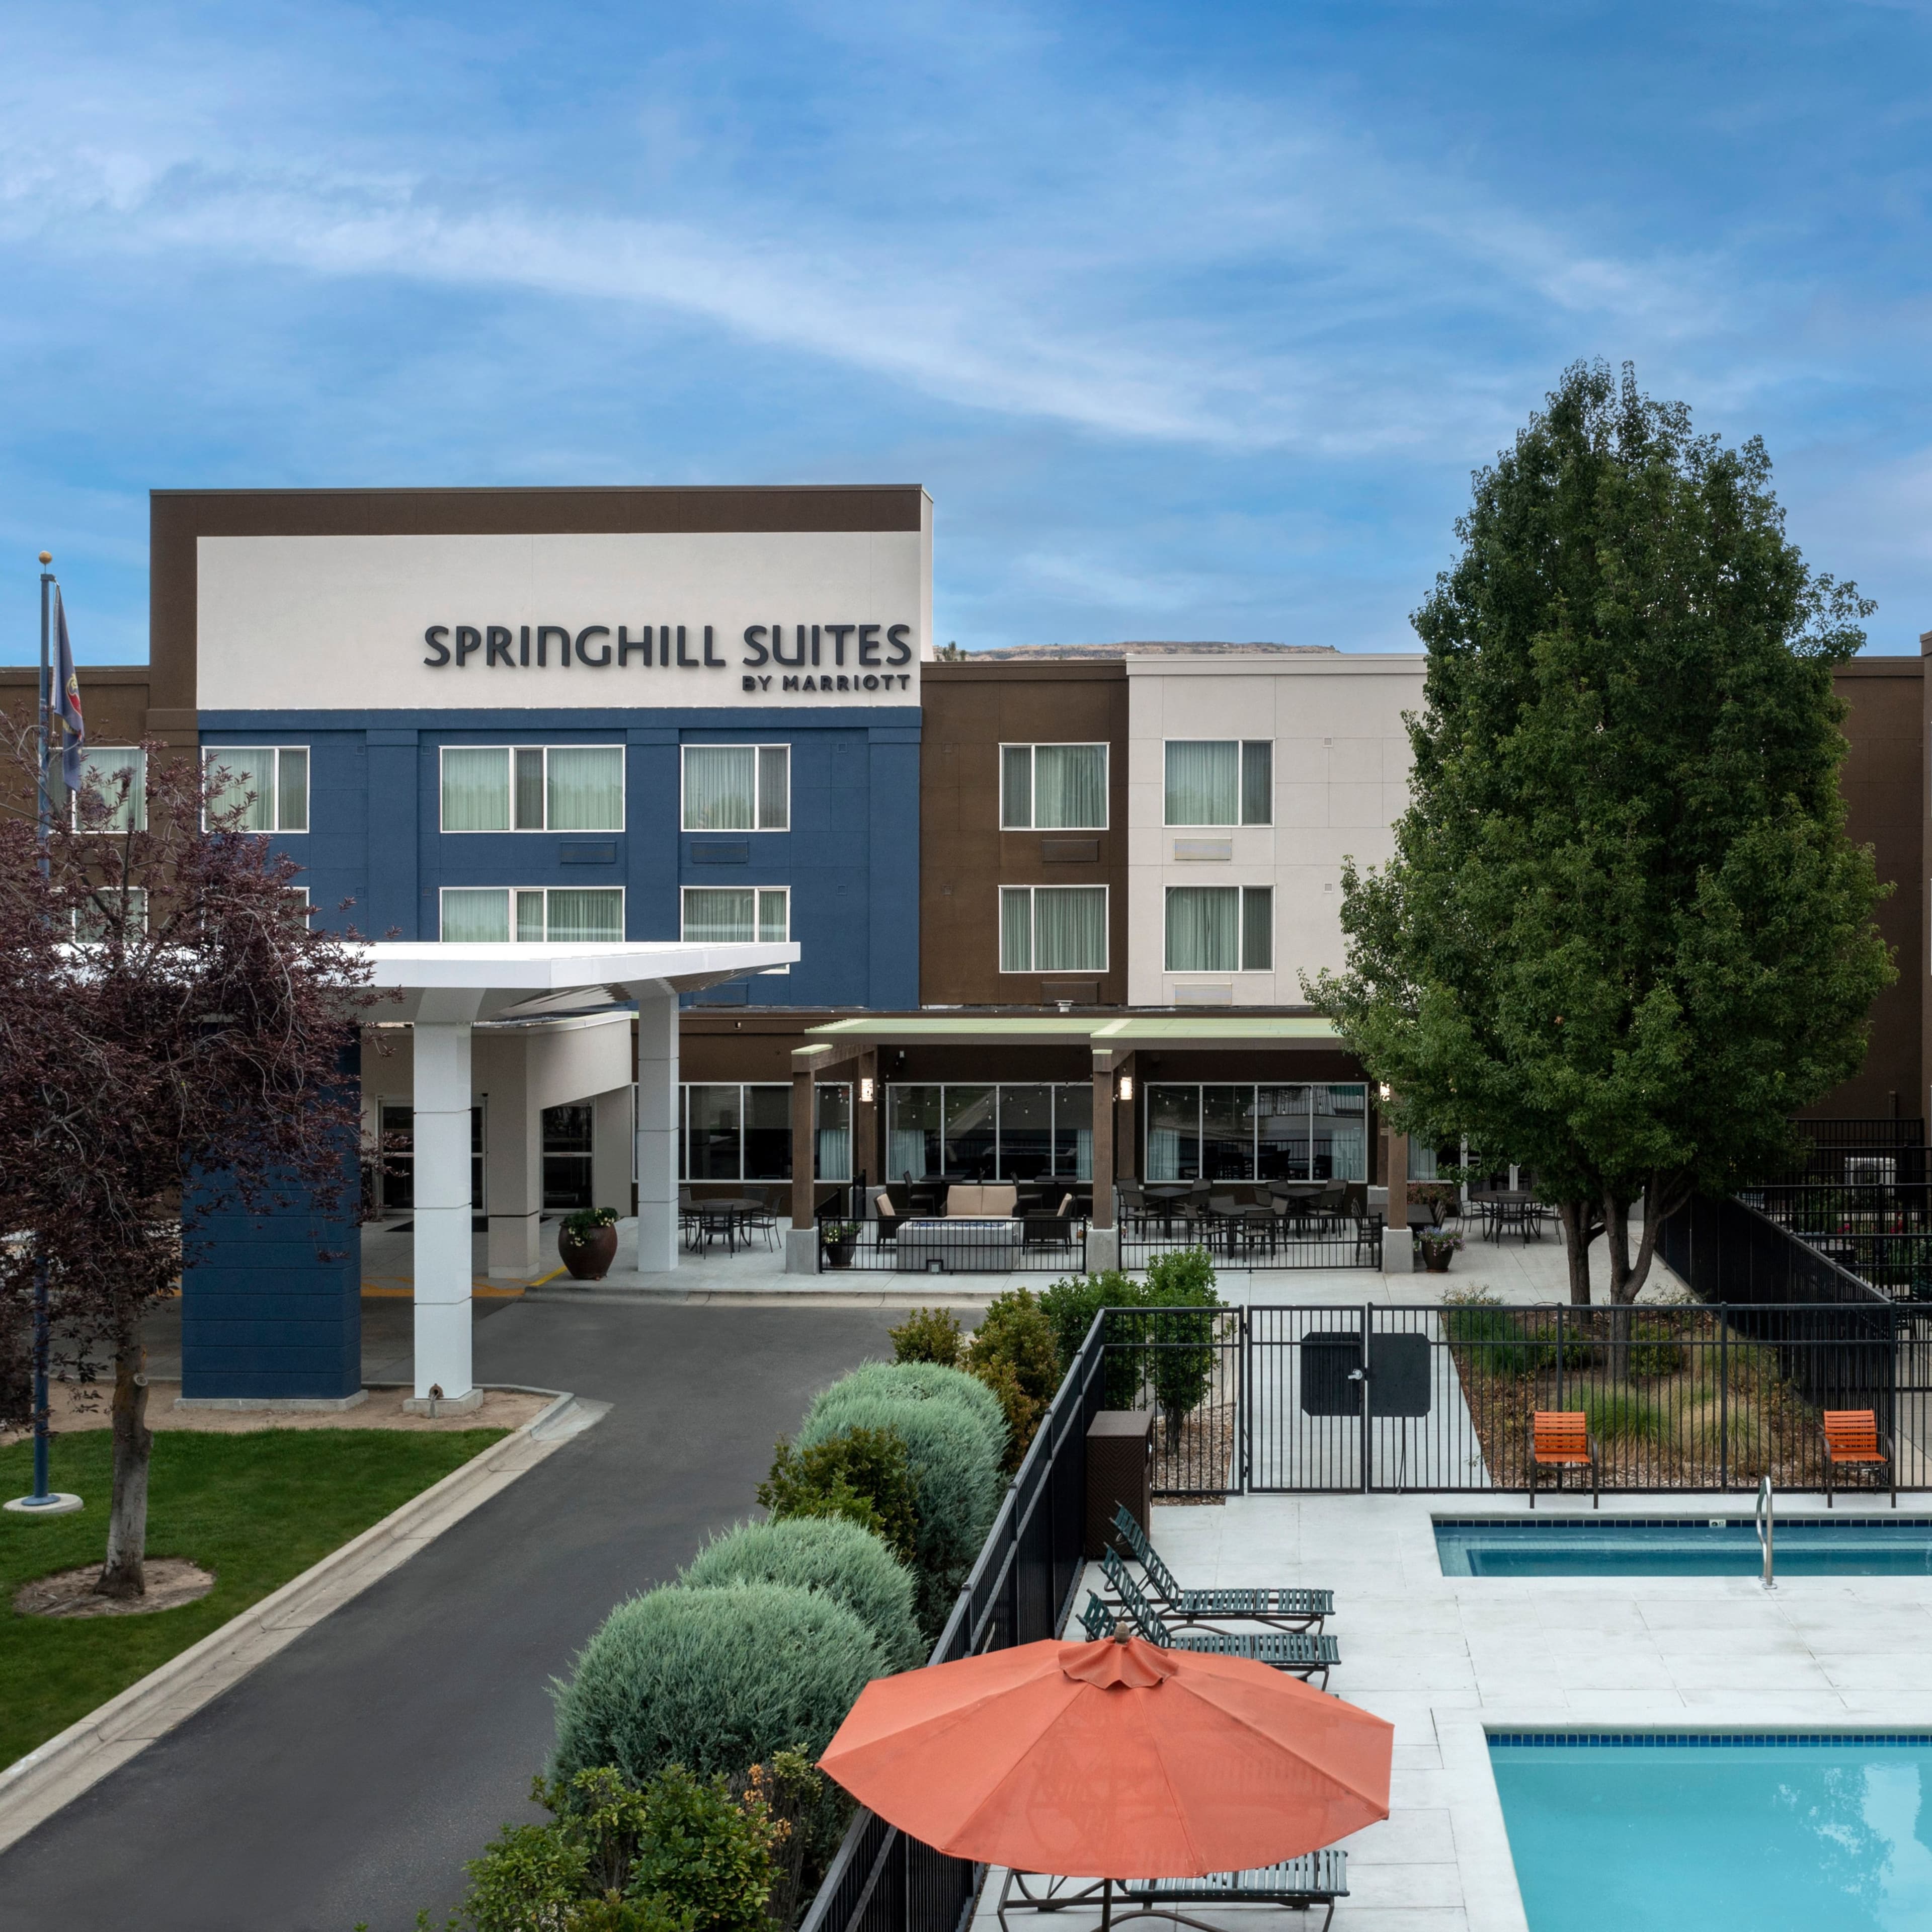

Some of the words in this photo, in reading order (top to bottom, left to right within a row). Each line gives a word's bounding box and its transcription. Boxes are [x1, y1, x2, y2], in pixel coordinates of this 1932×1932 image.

[424, 625, 727, 669] SPRINGHILL
[743, 624, 912, 669] SUITES
[743, 675, 772, 692] BY
[782, 675, 911, 692] MARRIOTT
